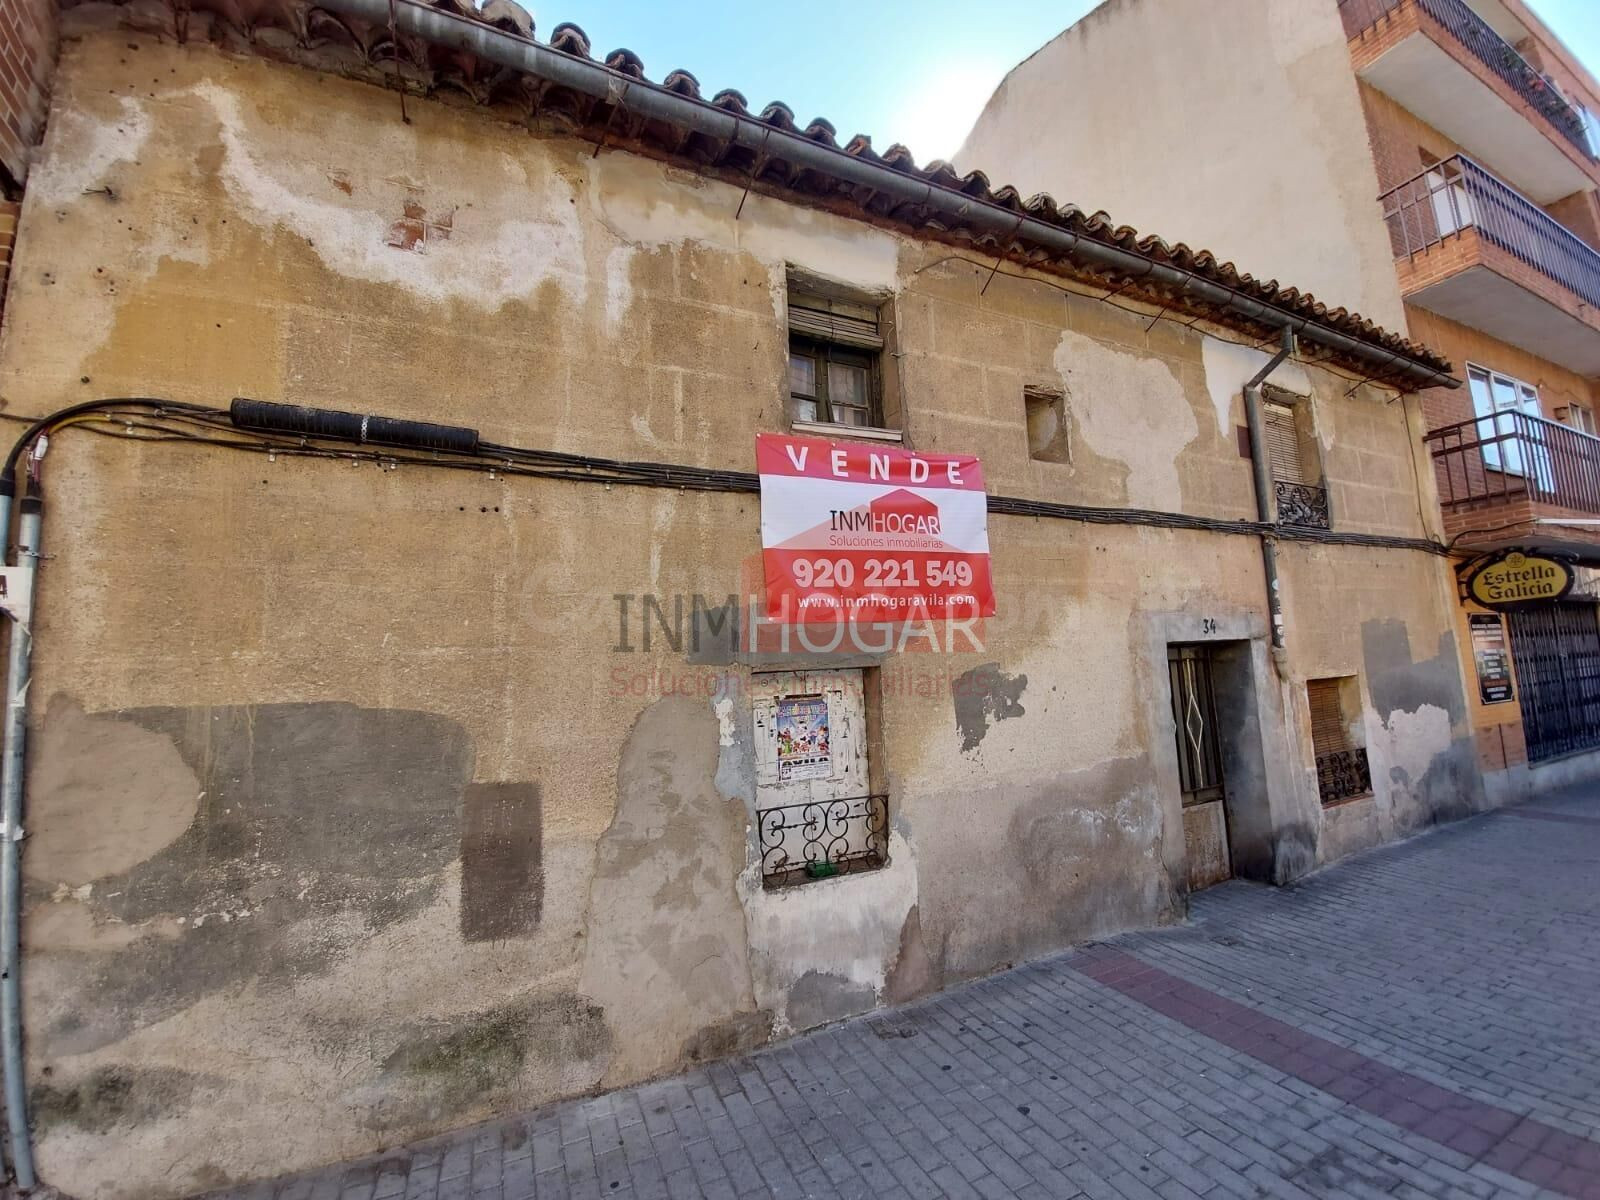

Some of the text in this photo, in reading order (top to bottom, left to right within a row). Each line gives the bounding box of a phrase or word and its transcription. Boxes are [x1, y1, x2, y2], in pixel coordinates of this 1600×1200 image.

[786, 445, 964, 484] VENDE
[829, 510, 942, 534] INMHOGAR
[829, 535, 943, 549] Soluciones inmobiliarias
[792, 558, 973, 587] 920 221 549
[1483, 565, 1556, 587] Estrella
[1488, 581, 1554, 600] Galicia
[798, 594, 975, 609] www.inmhogaravila.com
[1203, 618, 1216, 634] 34
